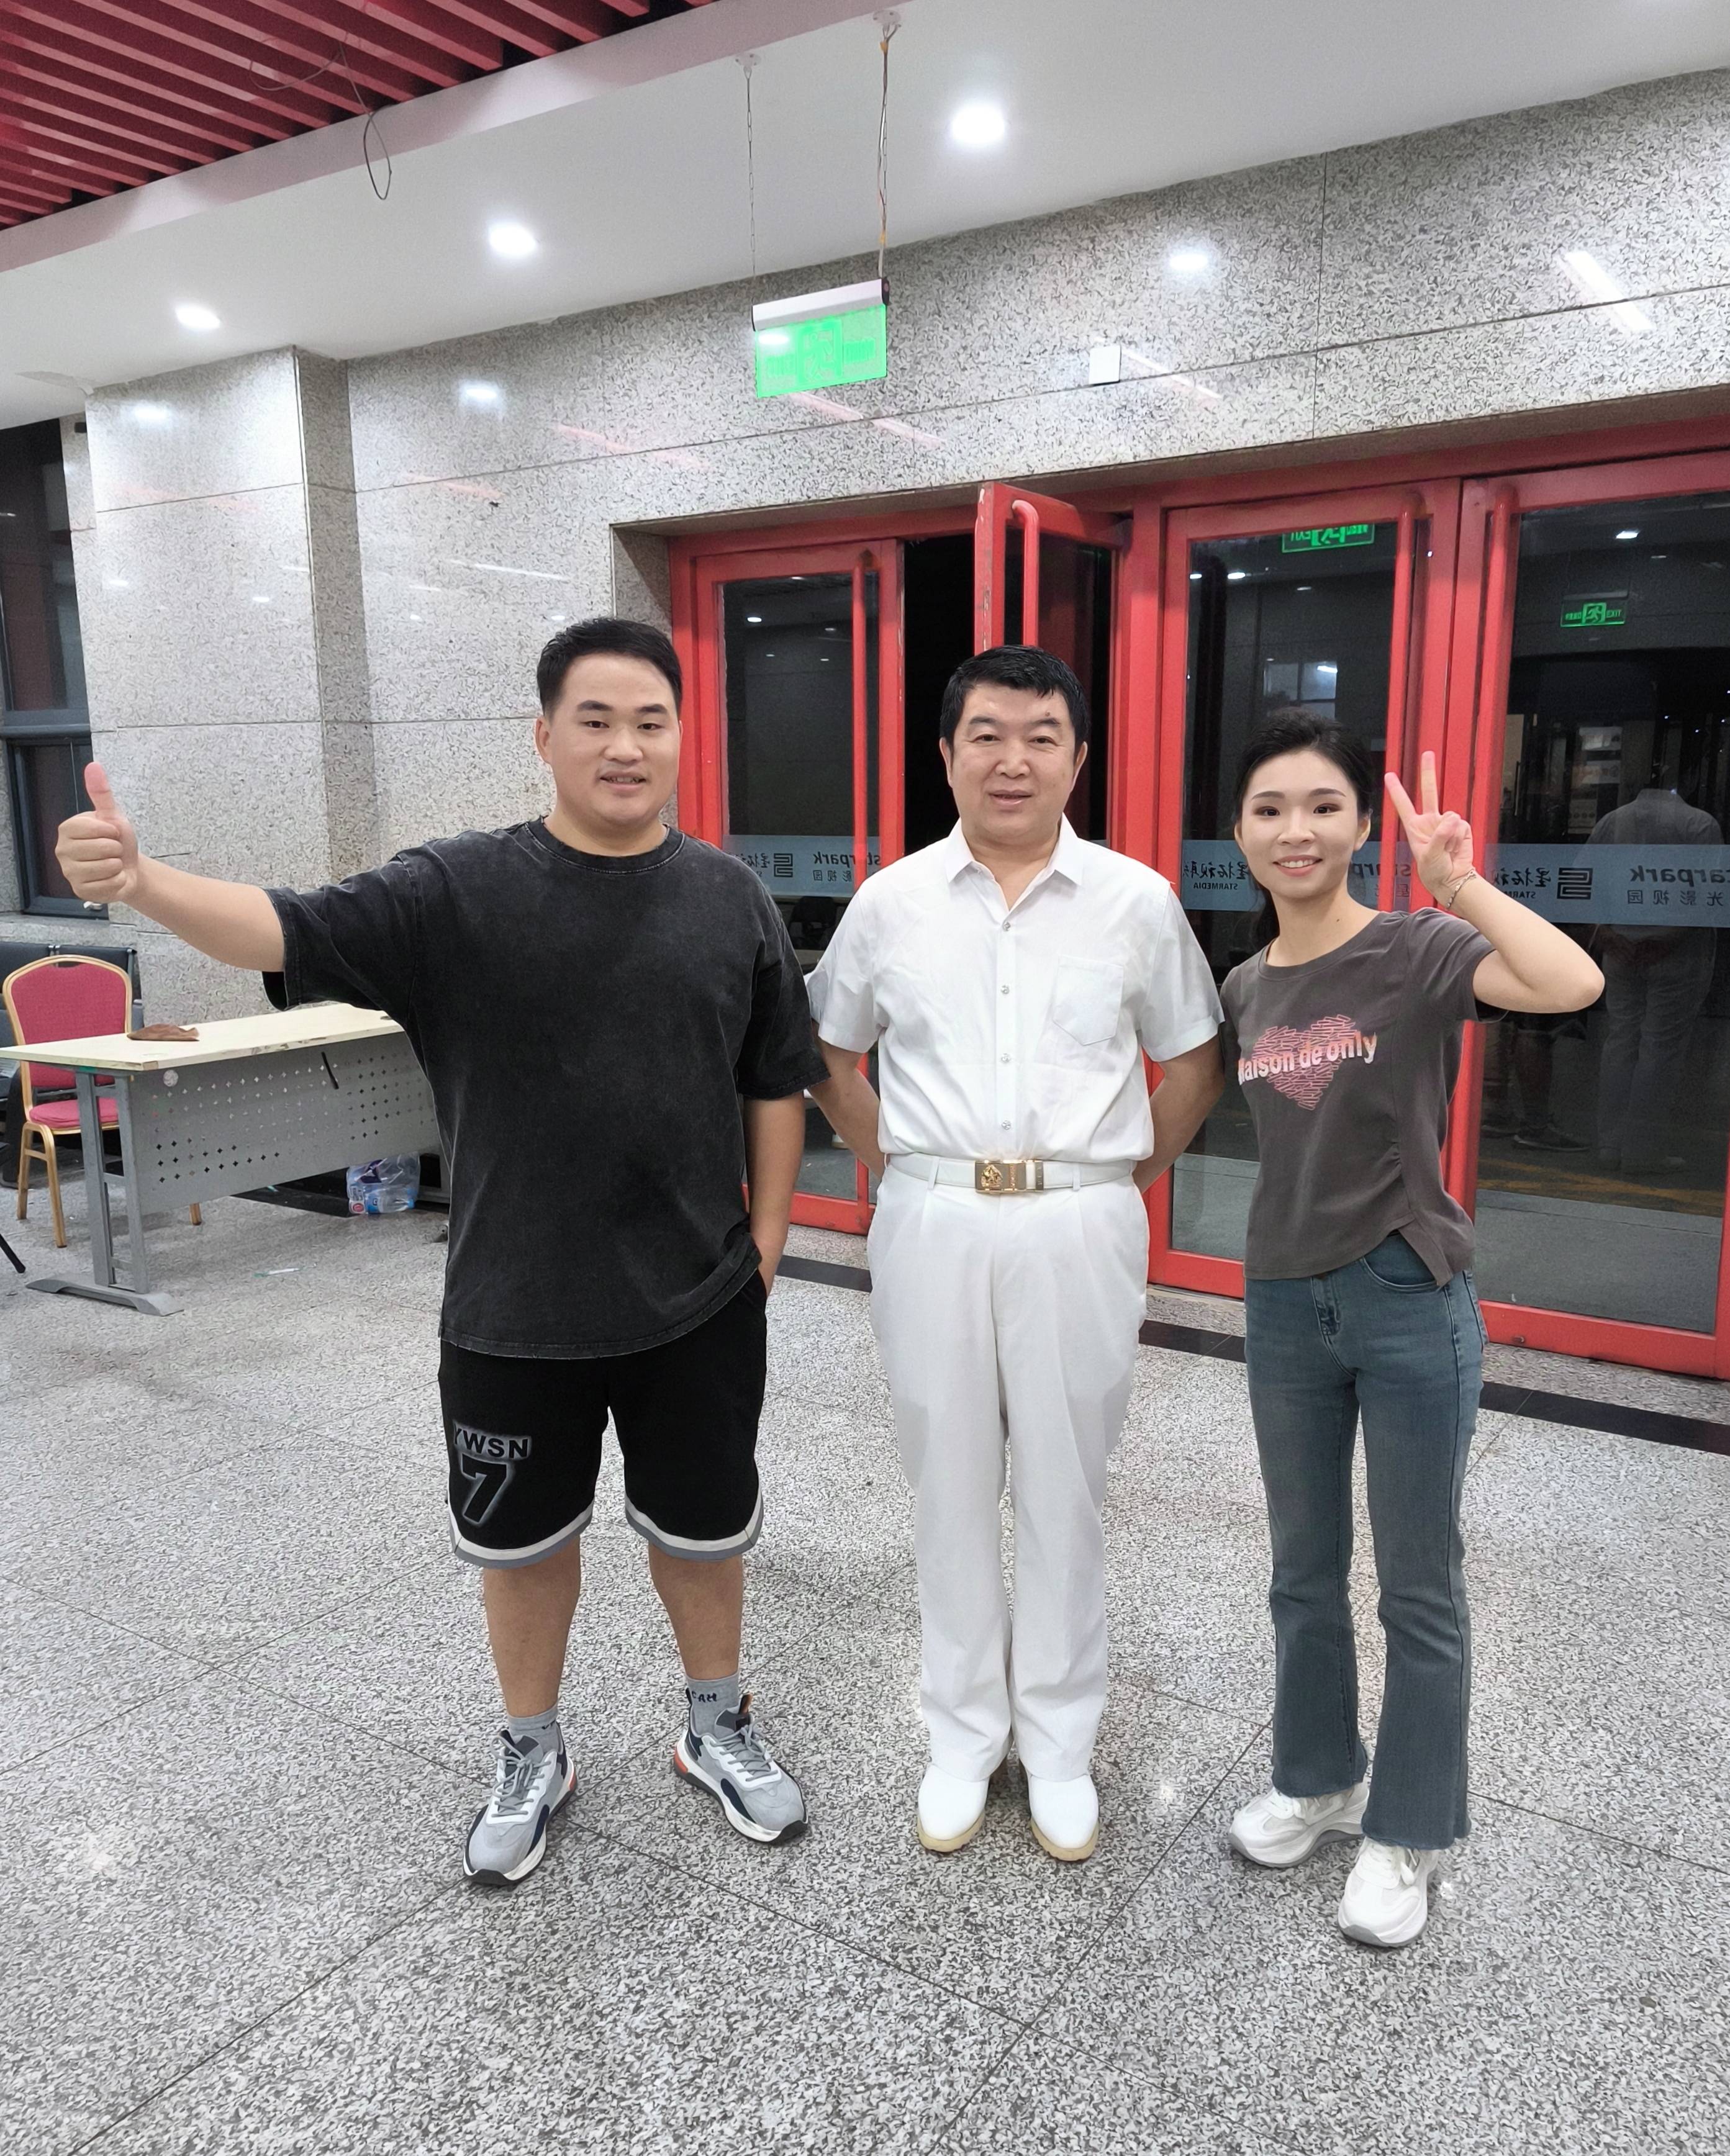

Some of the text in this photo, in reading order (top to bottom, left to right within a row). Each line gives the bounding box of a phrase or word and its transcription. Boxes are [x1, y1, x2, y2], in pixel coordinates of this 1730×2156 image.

[1298, 1042, 1322, 1068] de
[1326, 1031, 1377, 1064] only
[461, 1453, 508, 1523] 7
